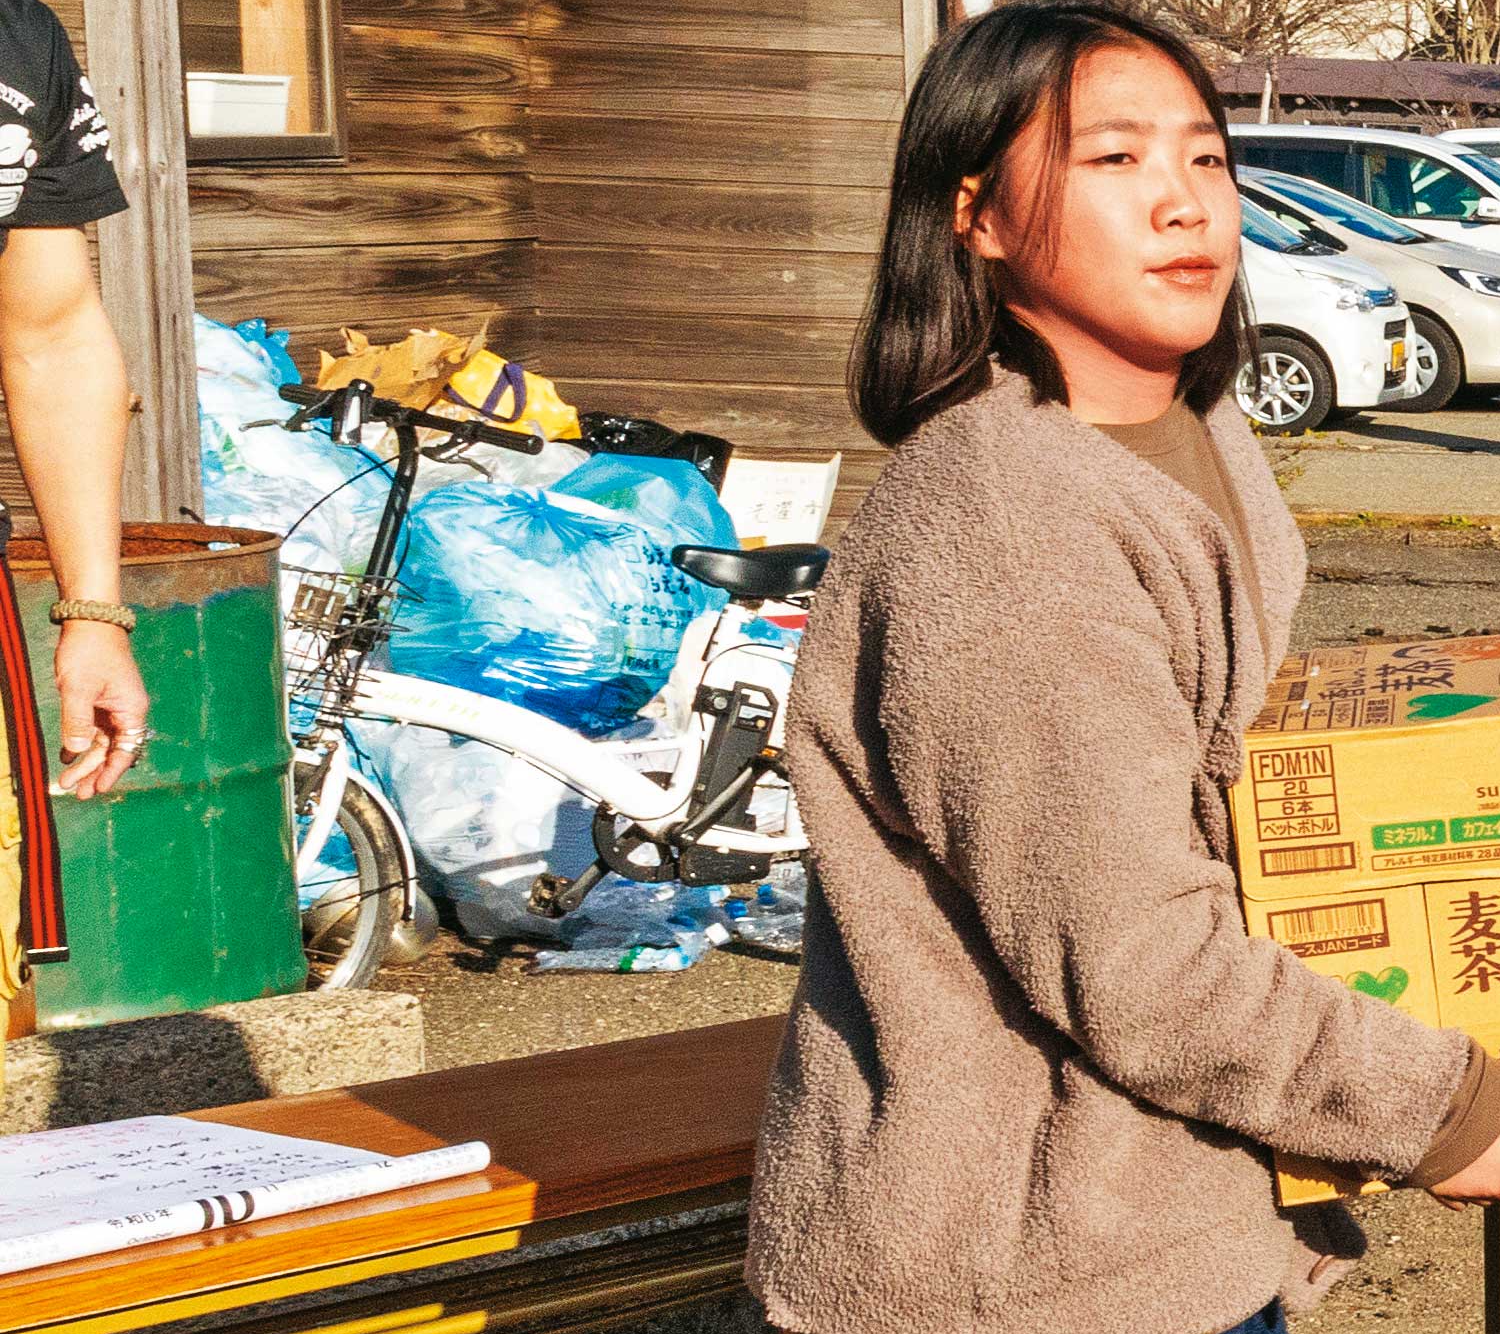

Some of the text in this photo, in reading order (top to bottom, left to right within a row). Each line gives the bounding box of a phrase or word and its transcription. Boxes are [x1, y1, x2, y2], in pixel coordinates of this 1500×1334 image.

[1259, 748, 1327, 778] FDM1N
[1281, 801, 1315, 816] 6本
[1263, 818, 1335, 836] ペットボトル
[1383, 826, 1437, 845] ミネラル!
[1288, 935, 1384, 957] ースJANコード
